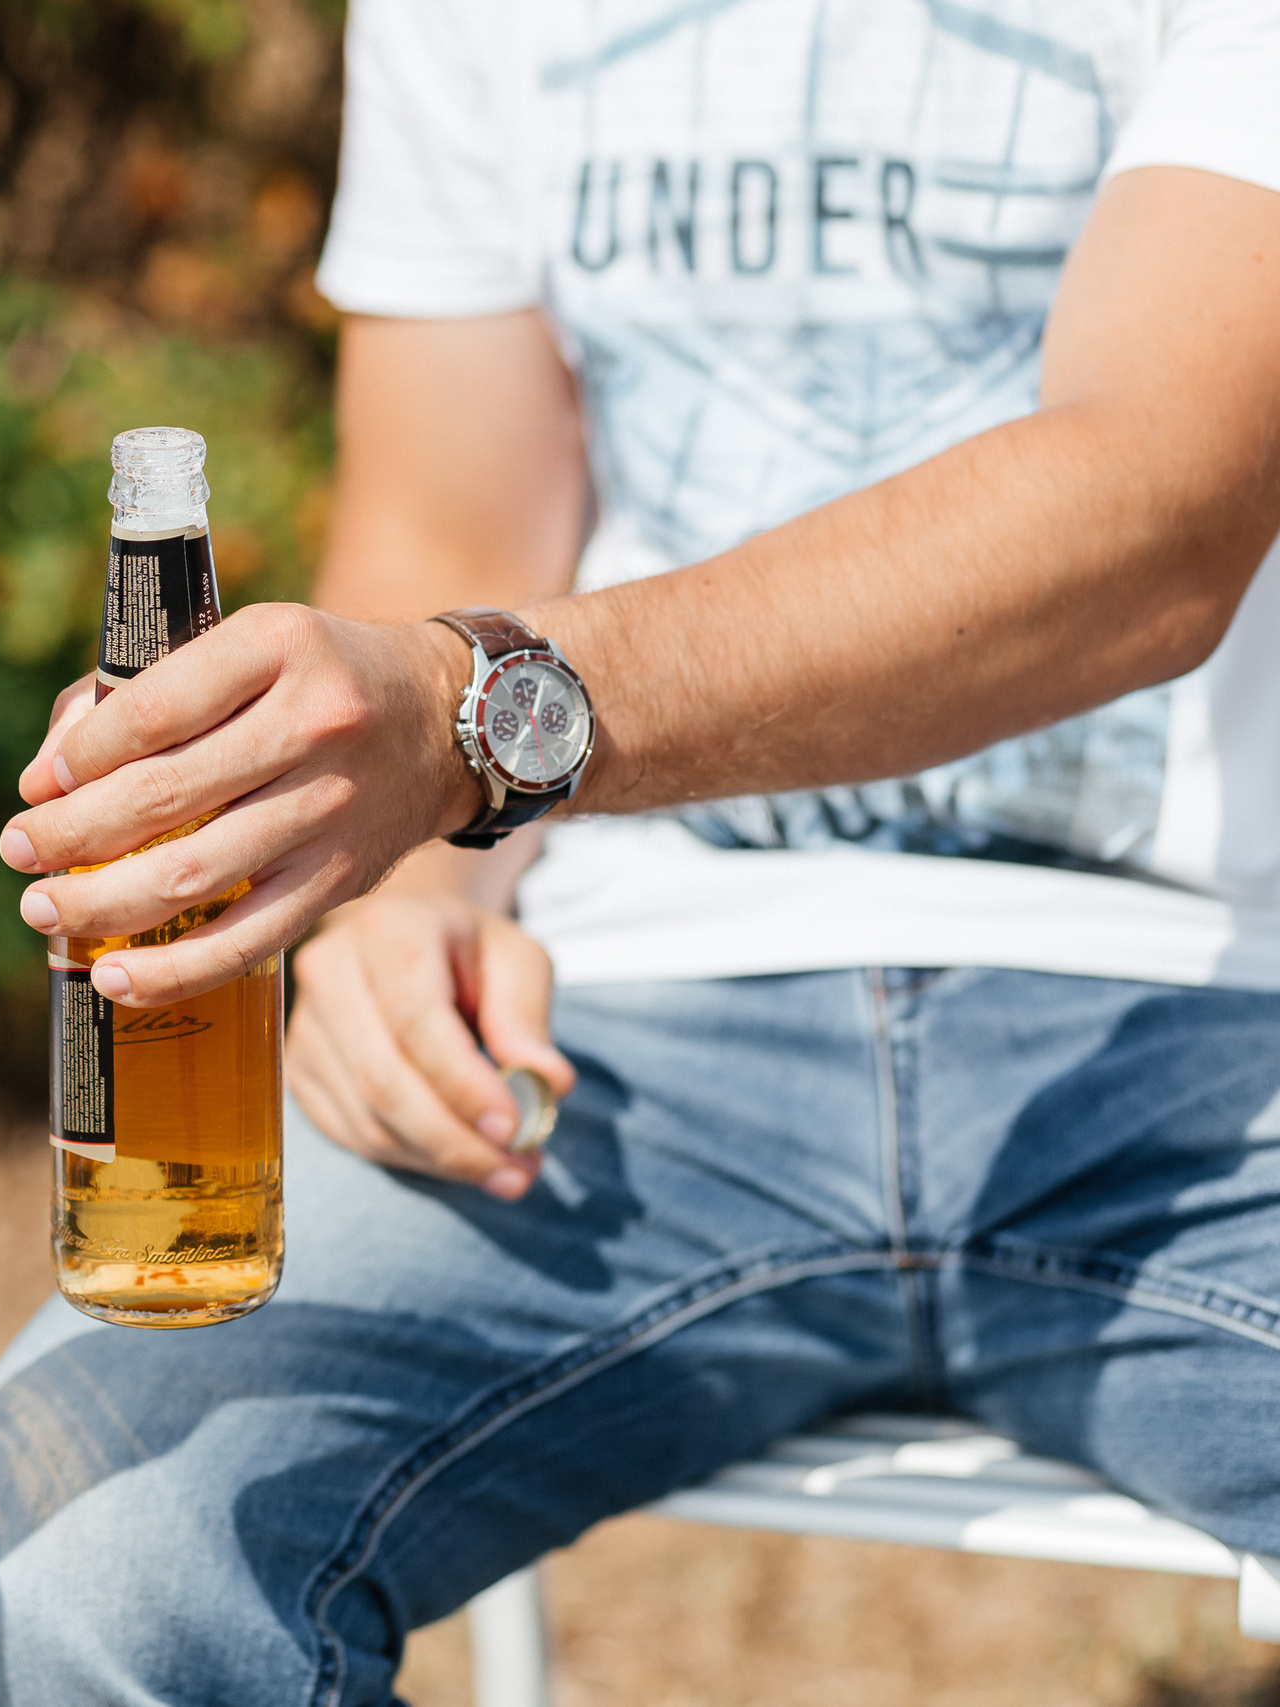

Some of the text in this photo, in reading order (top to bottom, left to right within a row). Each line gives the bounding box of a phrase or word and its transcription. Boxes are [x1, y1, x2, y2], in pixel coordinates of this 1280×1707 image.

[572, 158, 927, 278] UNDER
[199, 612, 207, 625] 22
[119, 623, 127, 666] ЗОВАННЫЙ.
